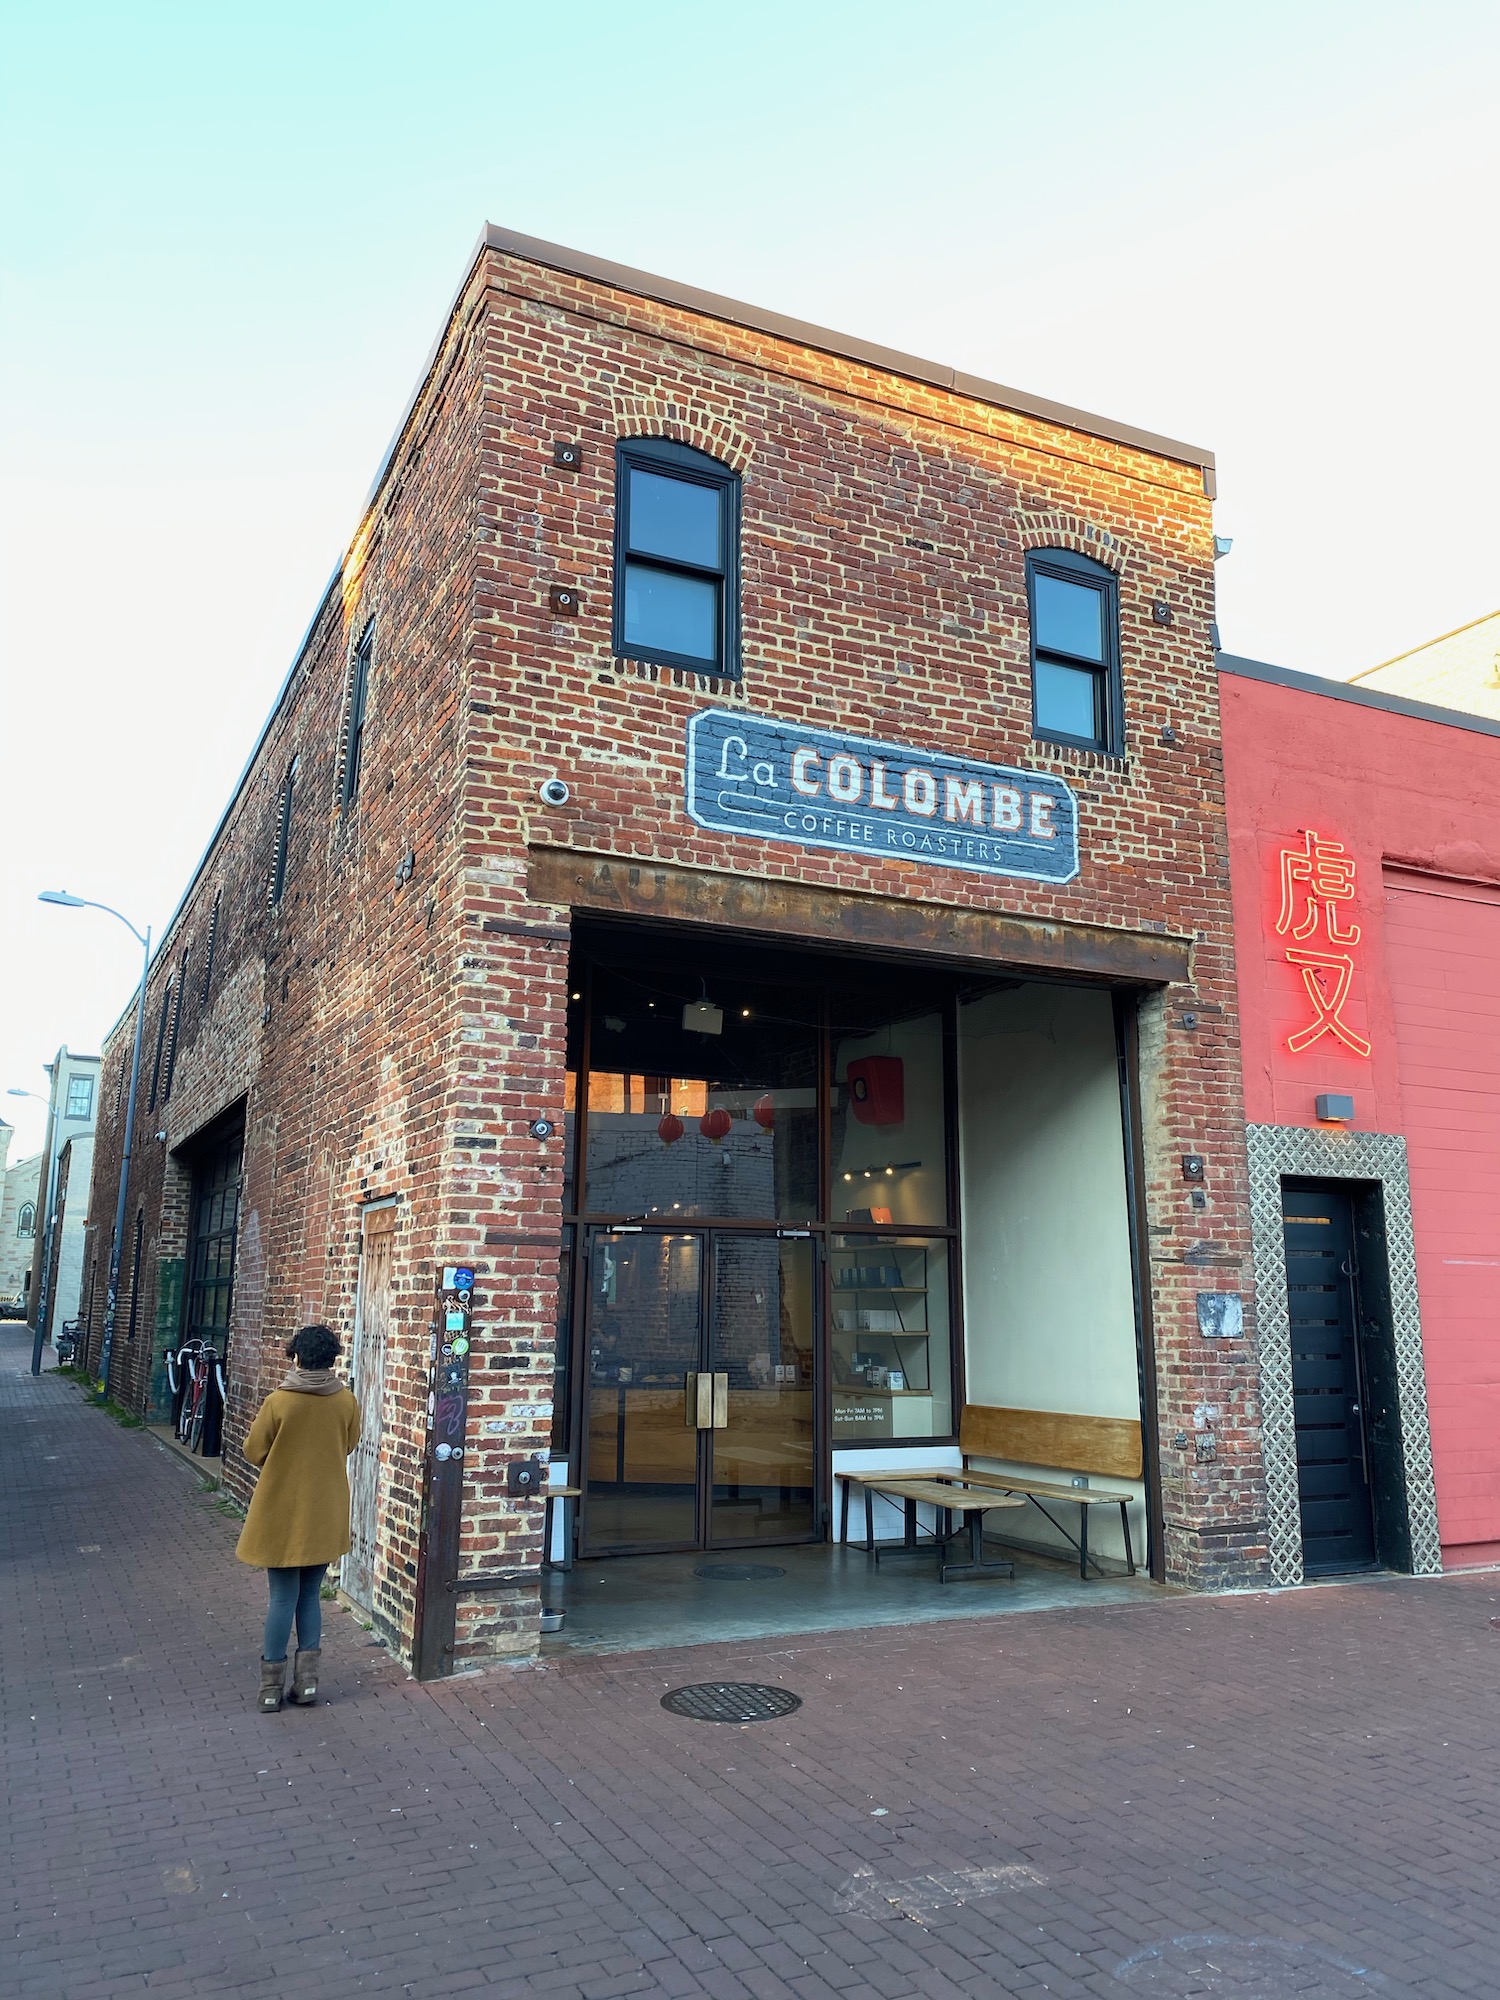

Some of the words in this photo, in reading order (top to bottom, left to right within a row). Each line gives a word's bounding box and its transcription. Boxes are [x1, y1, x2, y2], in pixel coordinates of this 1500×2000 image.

[716, 736, 778, 787] La
[791, 746, 1056, 839] COLOMBE
[784, 812, 873, 841] COFFEE
[887, 828, 1002, 861] ROASTERS
